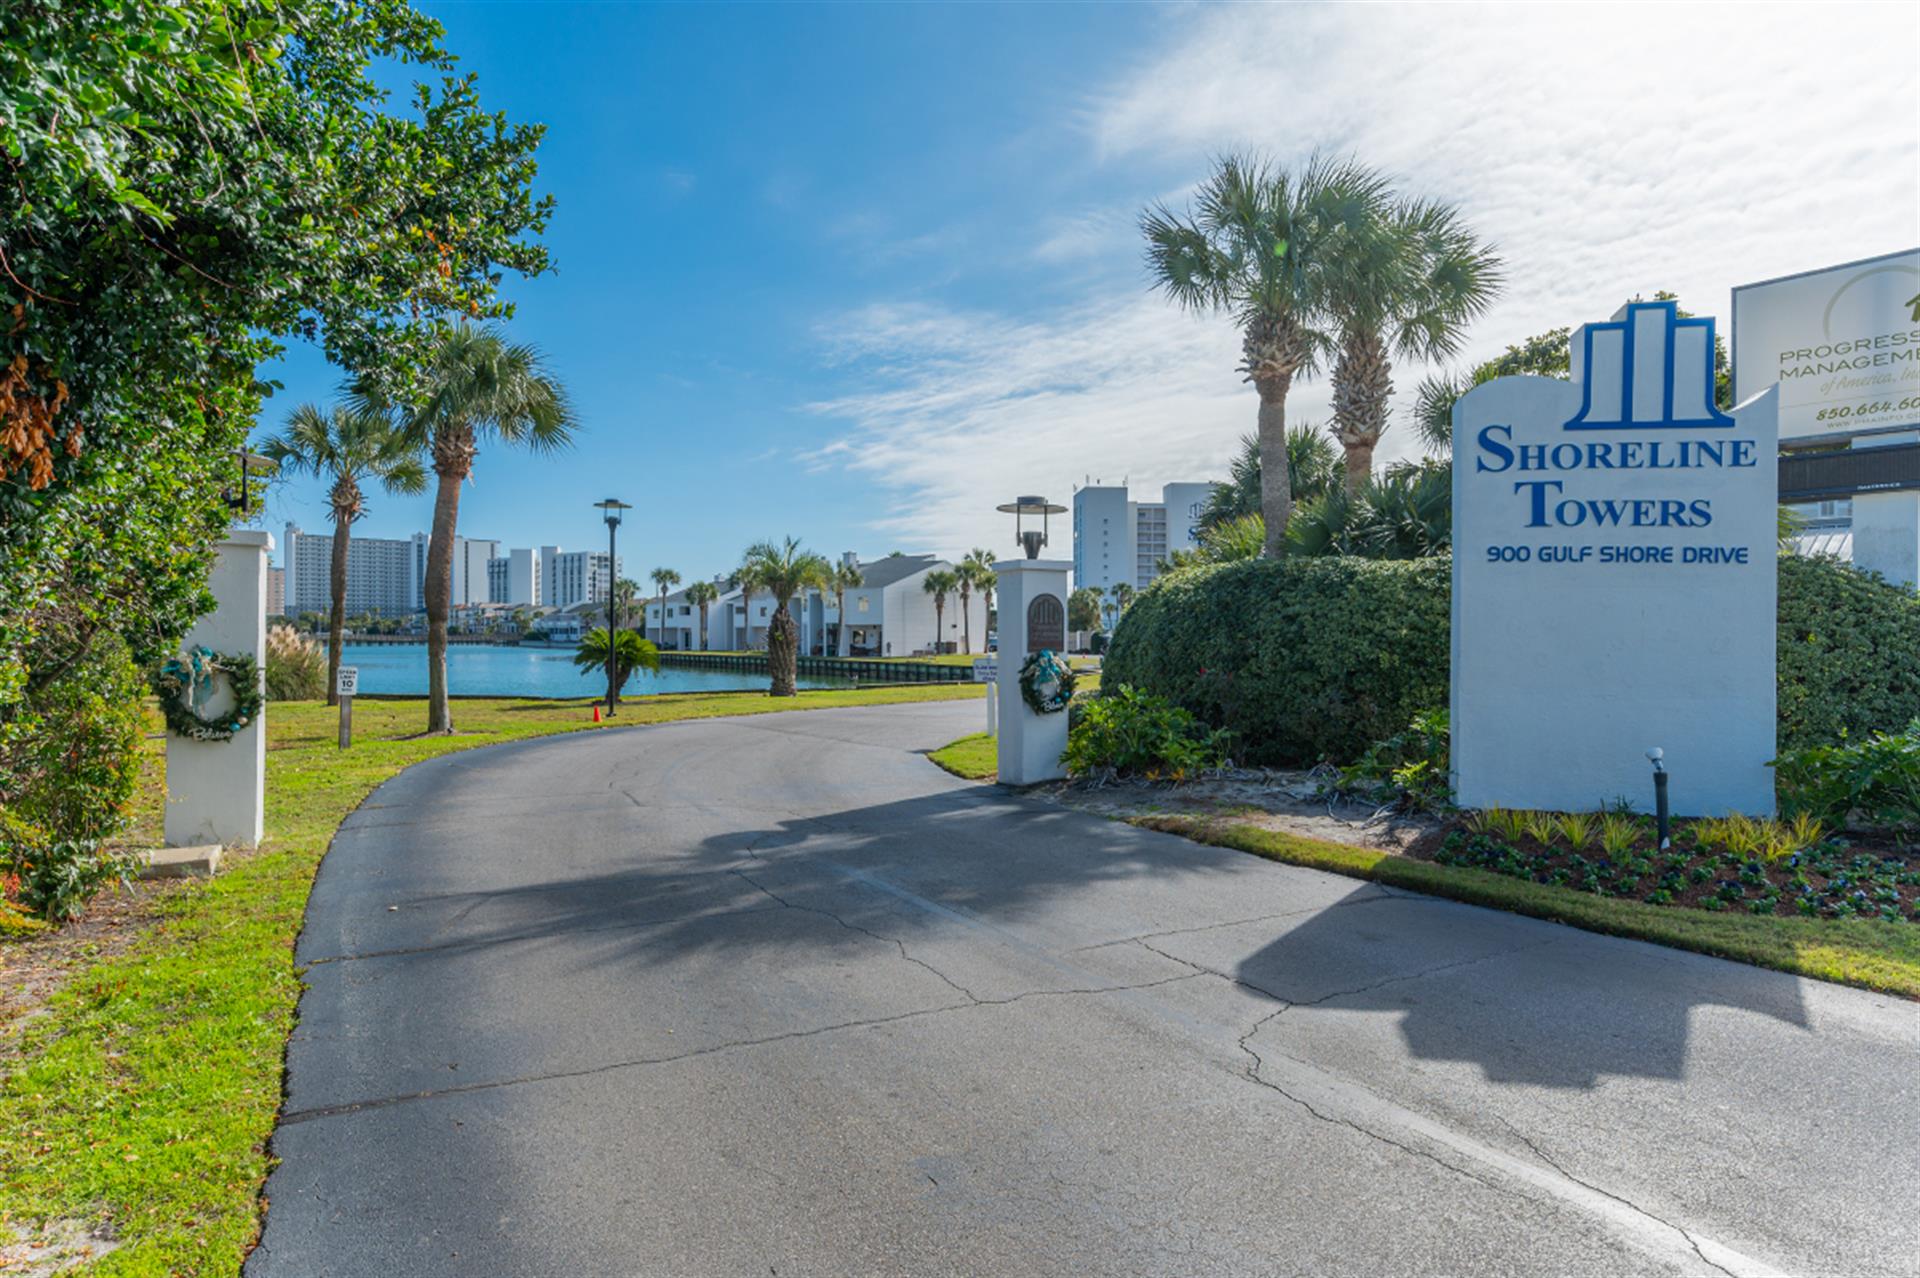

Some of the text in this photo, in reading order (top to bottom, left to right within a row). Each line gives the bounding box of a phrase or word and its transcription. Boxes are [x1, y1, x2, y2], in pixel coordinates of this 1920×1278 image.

[1780, 347, 1920, 381] MANAGEM
[1476, 424, 1758, 473] SHORELINE
[1514, 480, 1713, 528] TOWERS
[1487, 546, 1749, 564] 900 GULF SHORE DRIVE
[342, 680, 354, 688] 10
